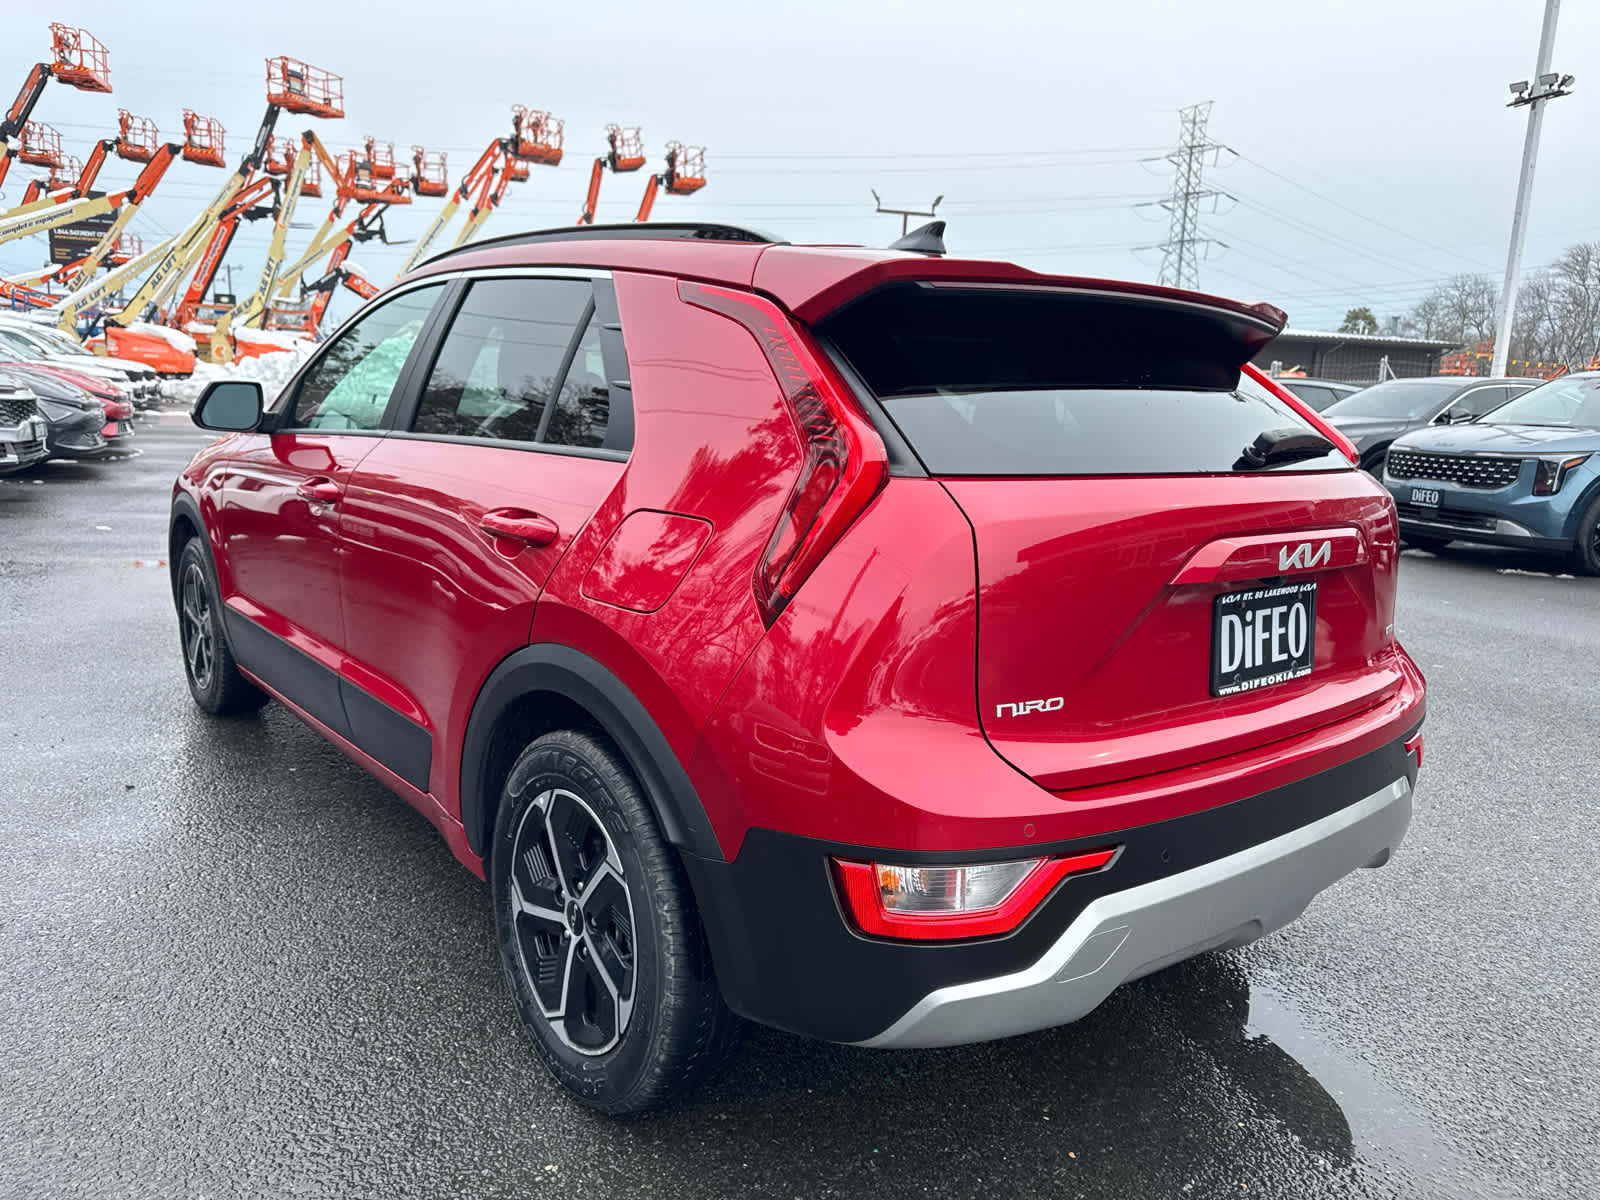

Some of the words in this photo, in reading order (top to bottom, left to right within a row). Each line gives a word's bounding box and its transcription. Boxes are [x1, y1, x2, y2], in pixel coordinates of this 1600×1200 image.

[161, 253, 176, 274] LIFT
[1278, 540, 1331, 571] KIA
[1242, 592, 1254, 601] RT.
[1264, 585, 1299, 597] LAKEWOOD
[1221, 602, 1308, 673] DiFEO
[1218, 668, 1312, 696] www.DIFEOKIA.com
[996, 696, 1064, 718] NIRO
